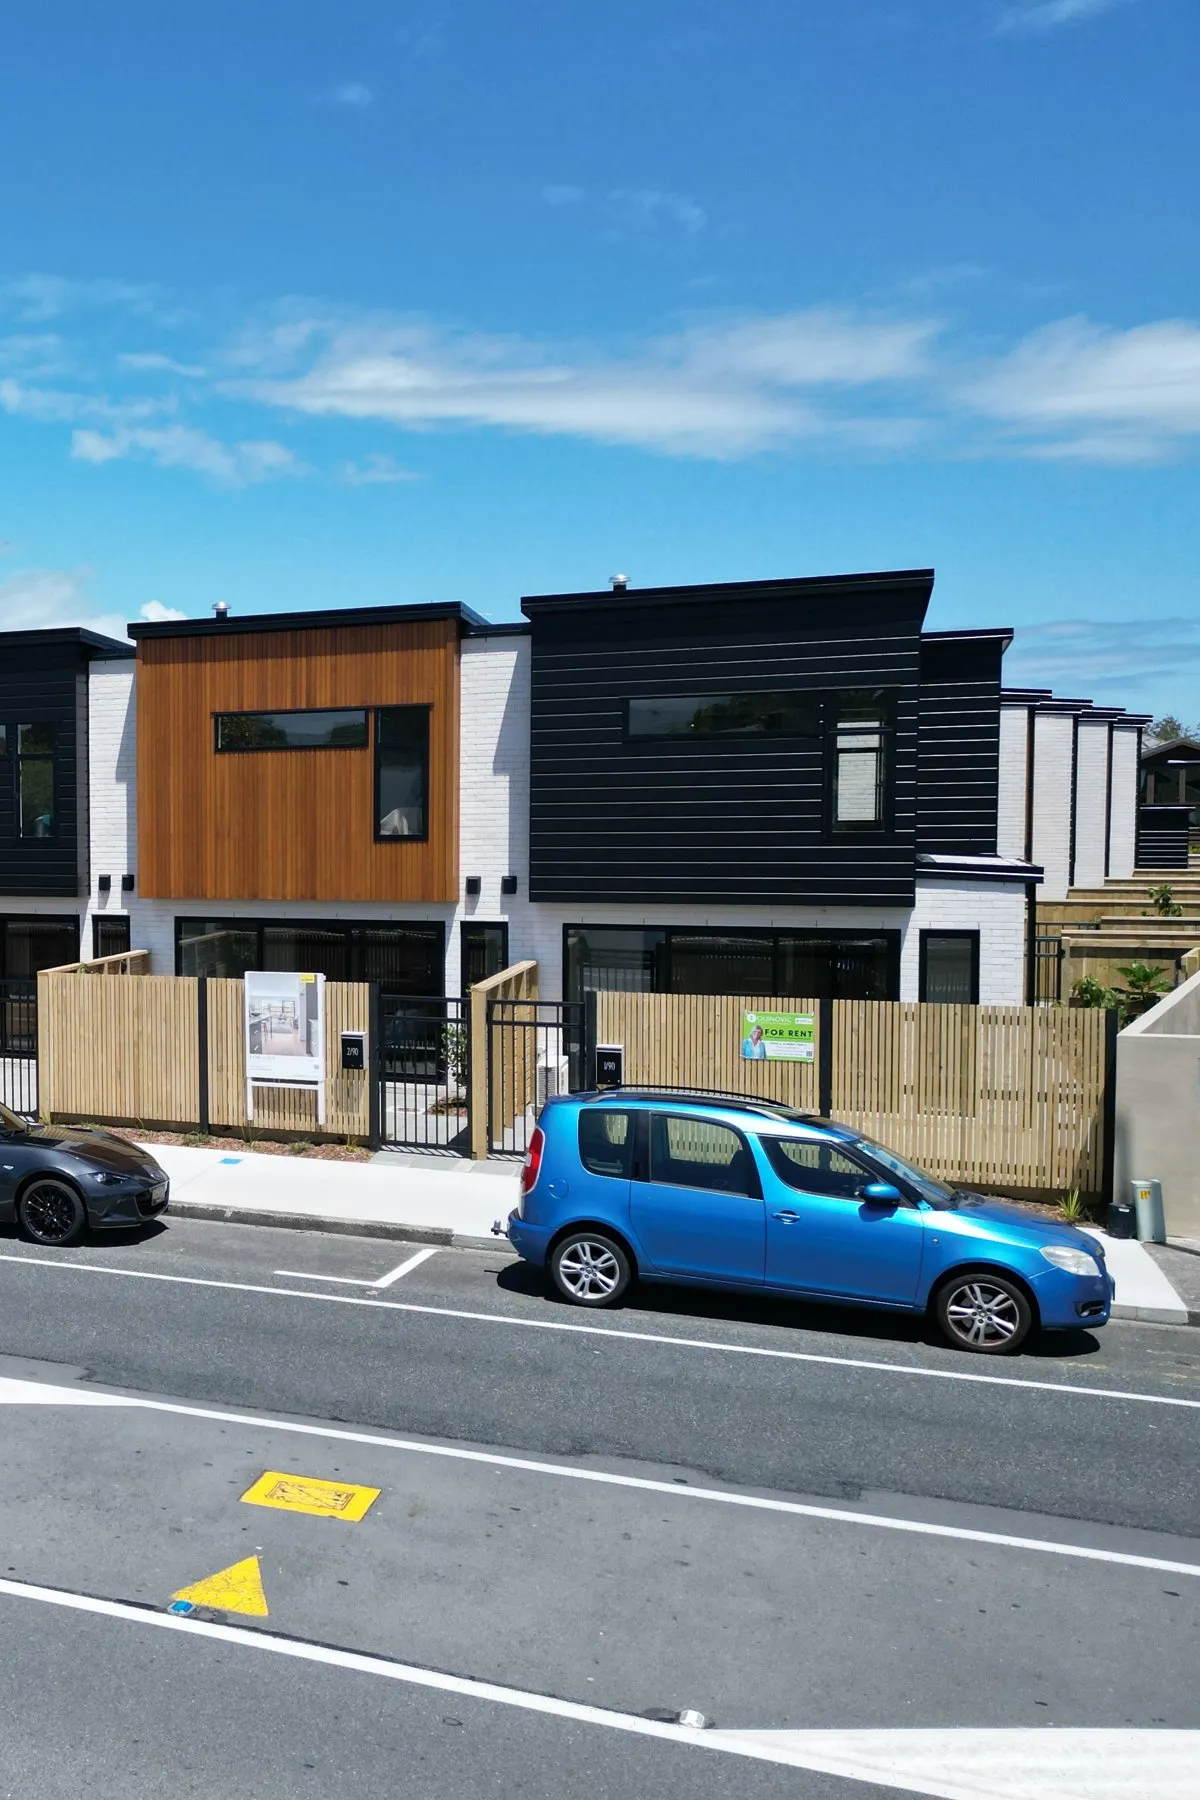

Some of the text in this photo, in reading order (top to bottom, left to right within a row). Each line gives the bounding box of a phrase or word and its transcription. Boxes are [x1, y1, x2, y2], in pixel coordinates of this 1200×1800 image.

[763, 1028, 784, 1036] FOR
[788, 1030, 813, 1038] RENT
[346, 1047, 359, 1056] 2/90
